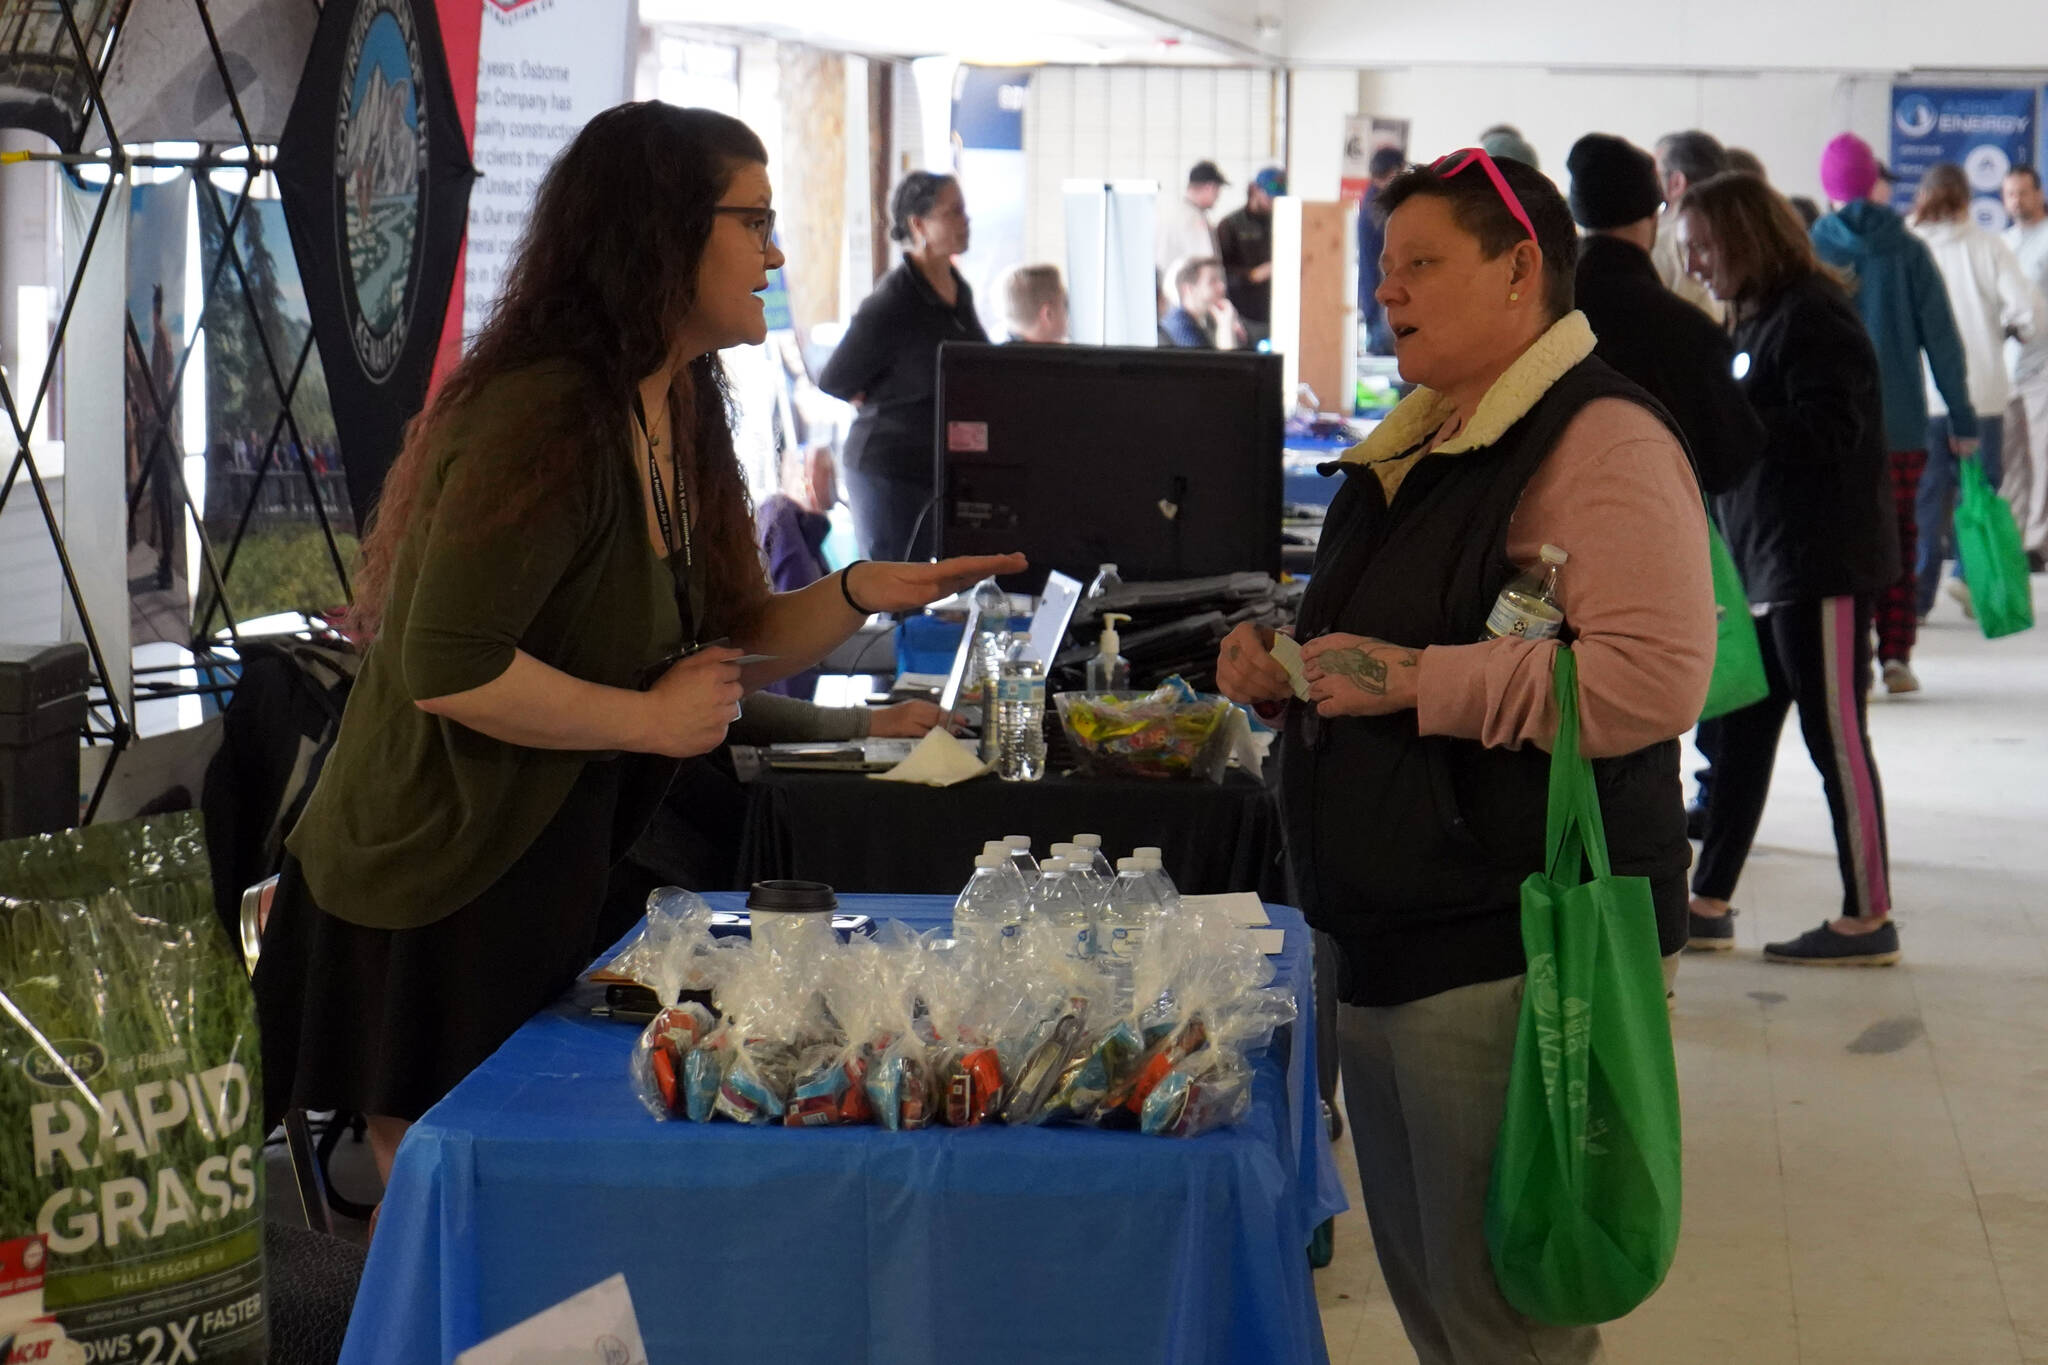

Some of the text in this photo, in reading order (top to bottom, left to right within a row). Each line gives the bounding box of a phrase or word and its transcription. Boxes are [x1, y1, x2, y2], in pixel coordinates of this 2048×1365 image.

[483, 2, 539, 27] TRUCTION
[522, 60, 570, 82] Osborne
[494, 87, 547, 113] Company
[551, 92, 572, 112] has
[476, 120, 505, 143] uality
[1938, 113, 2030, 136] ENERGY
[487, 148, 522, 167] clients
[486, 178, 523, 197] United
[483, 206, 502, 225] Our
[467, 238, 494, 254] neral
[30, 1062, 250, 1177] RAPID
[36, 1144, 256, 1254] GRASS
[112, 1272, 146, 1290] TALL
[149, 1256, 201, 1282] FESCUE
[83, 1333, 132, 1362] OWS
[135, 1315, 200, 1365] 2X
[202, 1292, 263, 1334] FASTER
